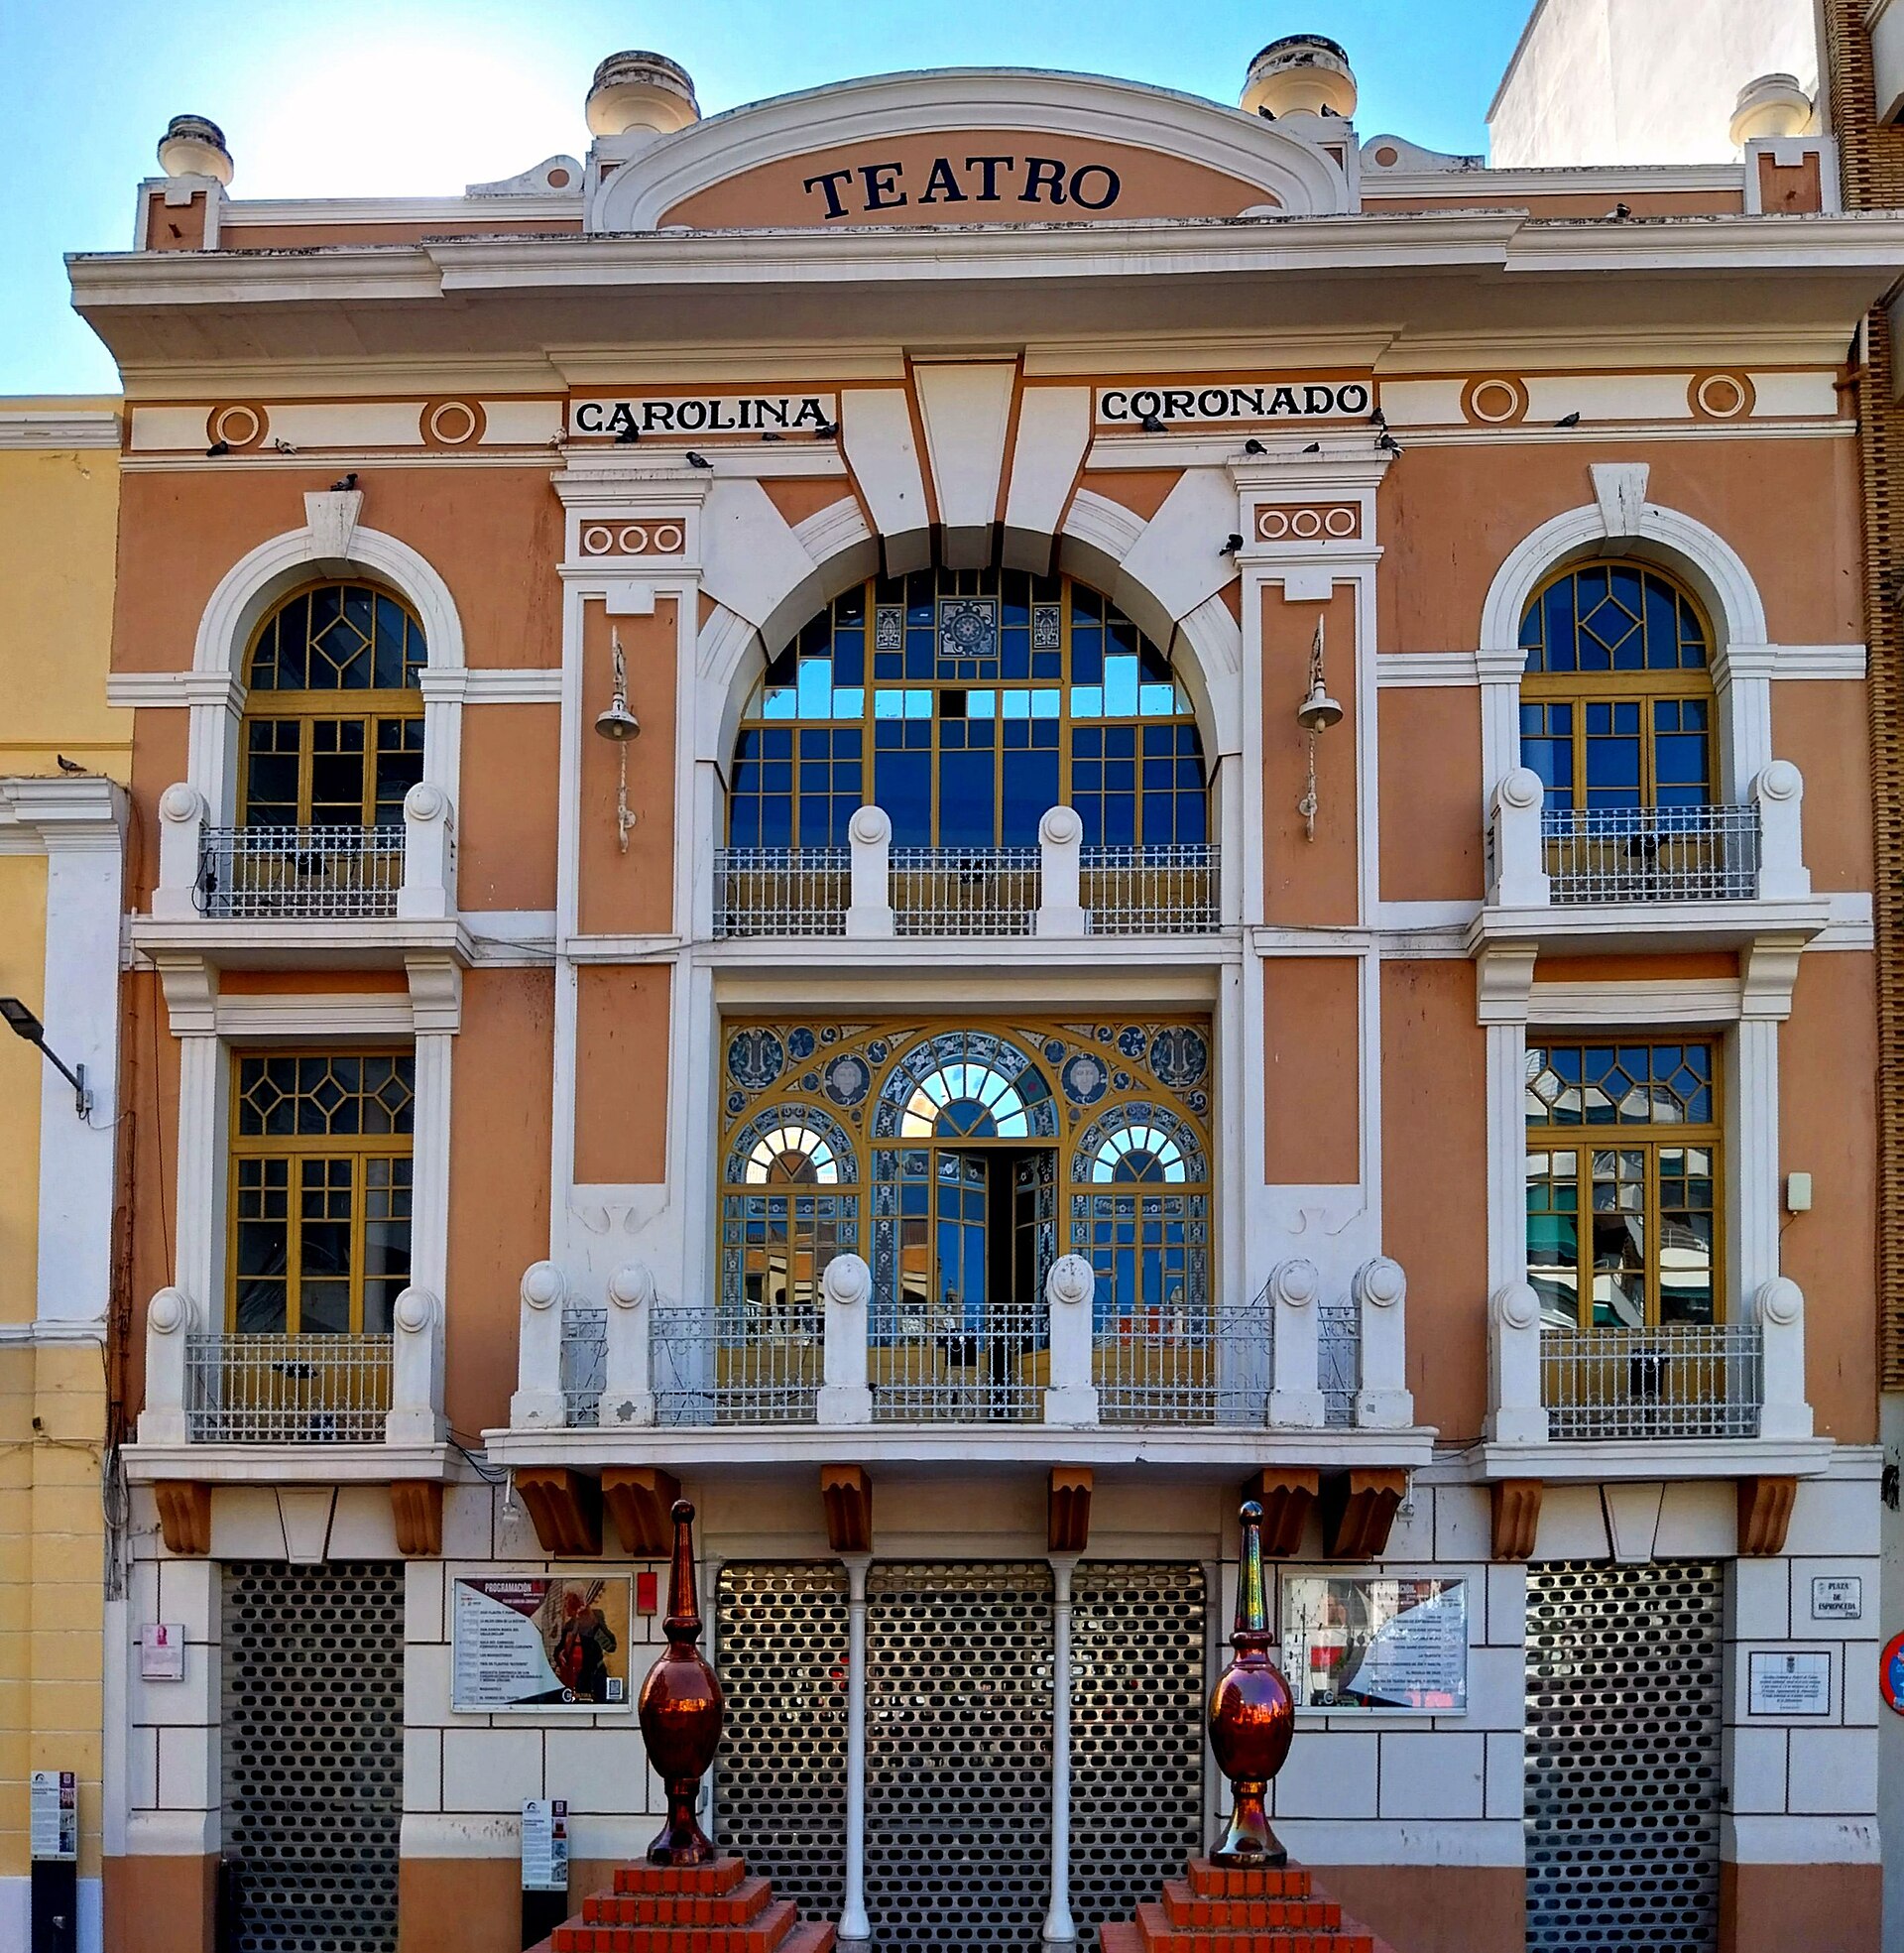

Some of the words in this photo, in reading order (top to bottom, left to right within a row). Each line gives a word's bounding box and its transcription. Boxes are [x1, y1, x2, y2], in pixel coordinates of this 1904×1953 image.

[803, 156, 1122, 219] TEATRO
[576, 398, 830, 432] CAROLINA
[1101, 384, 1368, 421] CORONADO
